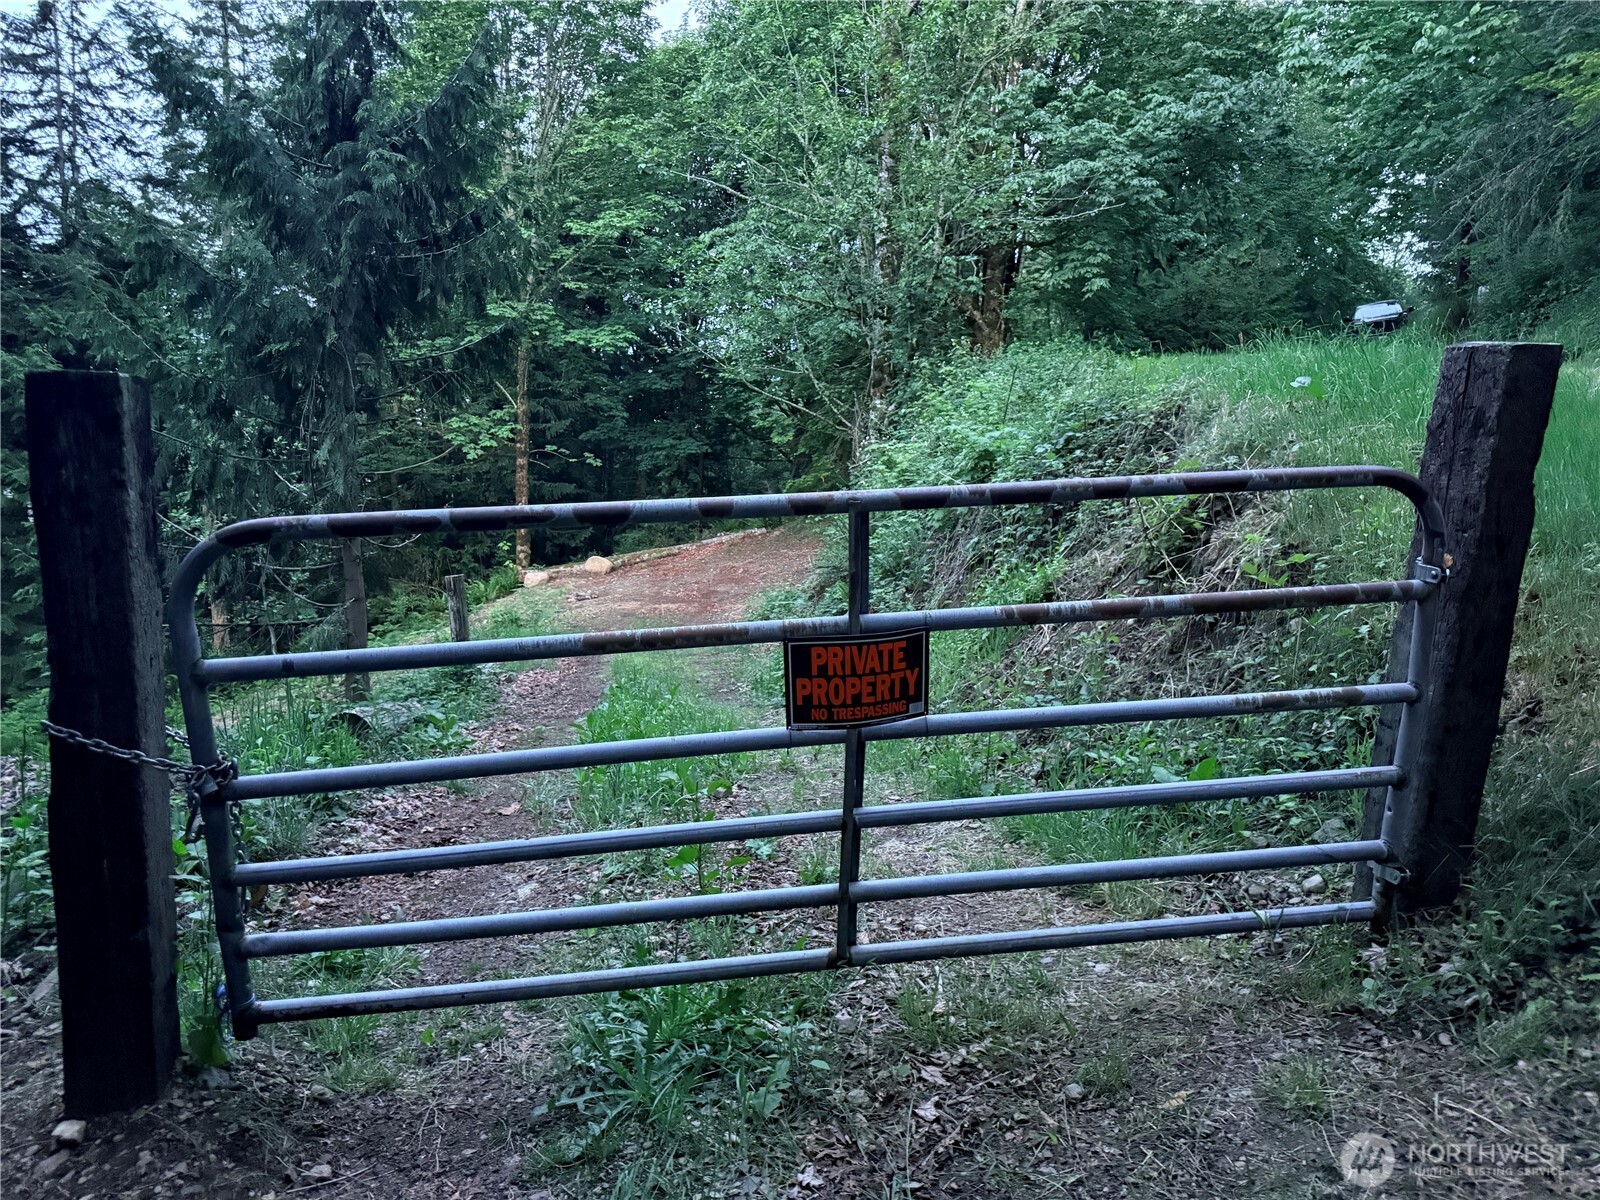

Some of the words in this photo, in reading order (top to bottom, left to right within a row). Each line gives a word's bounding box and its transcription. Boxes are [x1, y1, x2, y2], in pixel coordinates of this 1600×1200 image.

[811, 641, 907, 676] PRIVATE
[796, 668, 919, 706] PROPERTY
[811, 708, 828, 720] NO
[832, 700, 907, 720] TRESPASSING
